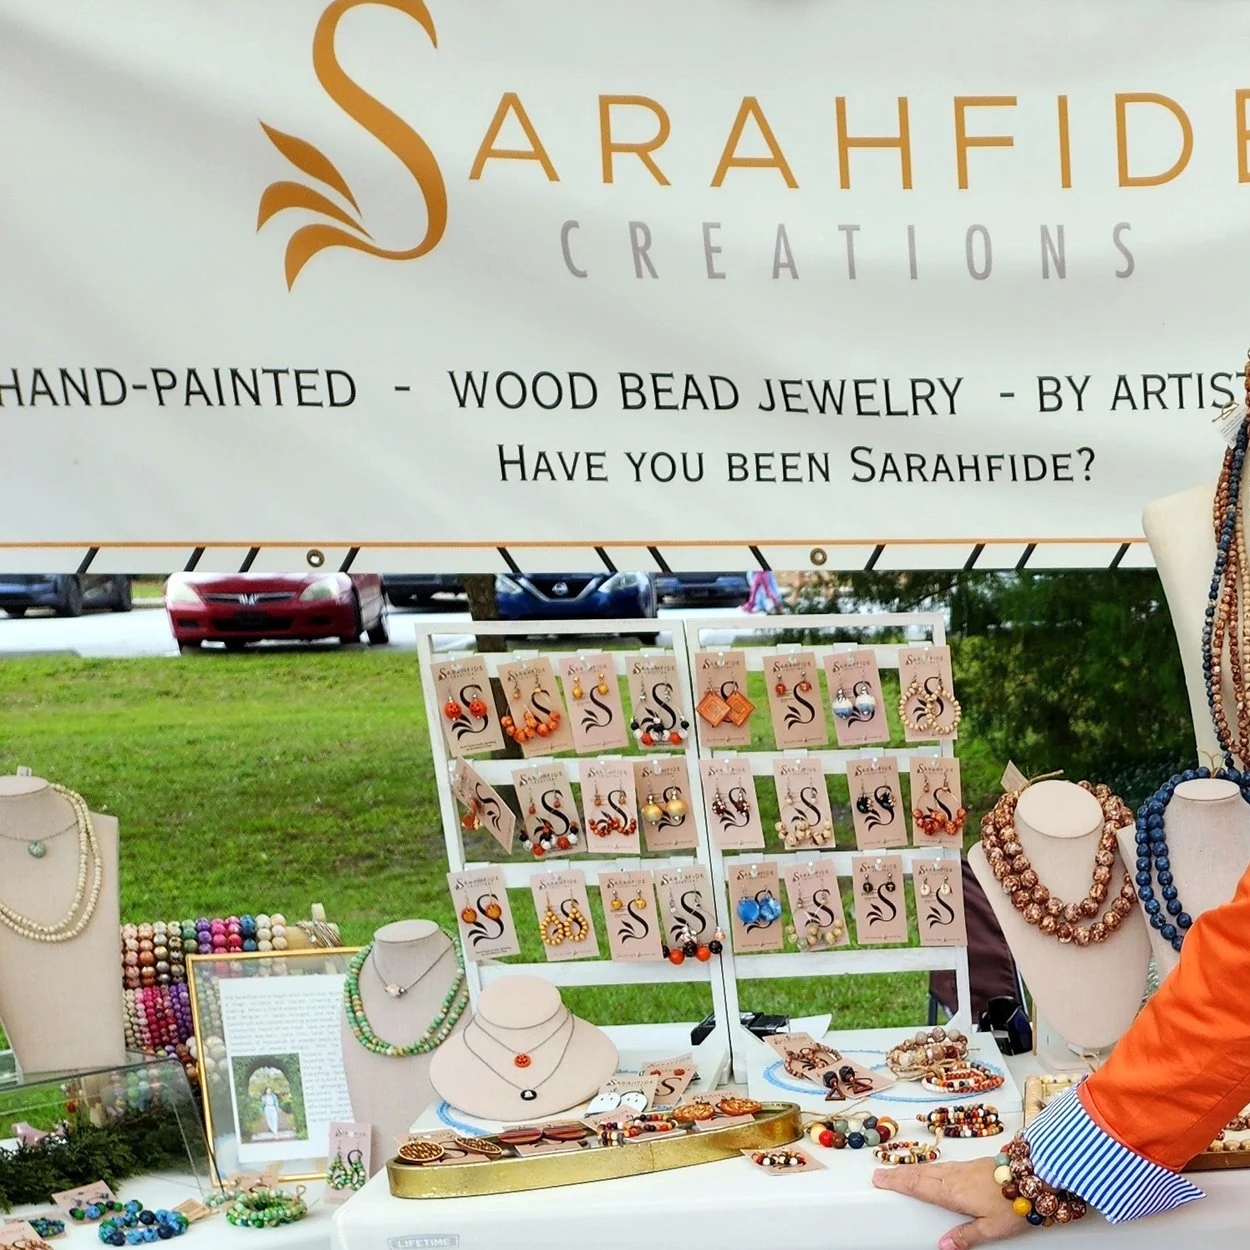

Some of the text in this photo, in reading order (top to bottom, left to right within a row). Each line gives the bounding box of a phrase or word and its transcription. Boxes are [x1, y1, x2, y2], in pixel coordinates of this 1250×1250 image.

[560, 219, 1136, 281] CREATIONS
[0, 367, 356, 408] HAND-PAINTED
[448, 370, 598, 410] WOOD
[618, 372, 739, 411] BEAD
[758, 377, 963, 417] JEWELRY
[1038, 376, 1091, 413] BY
[1110, 370, 1245, 411] ARTIS
[497, 444, 1095, 483] HAVE YOU BEEN SARAHFIDE?
